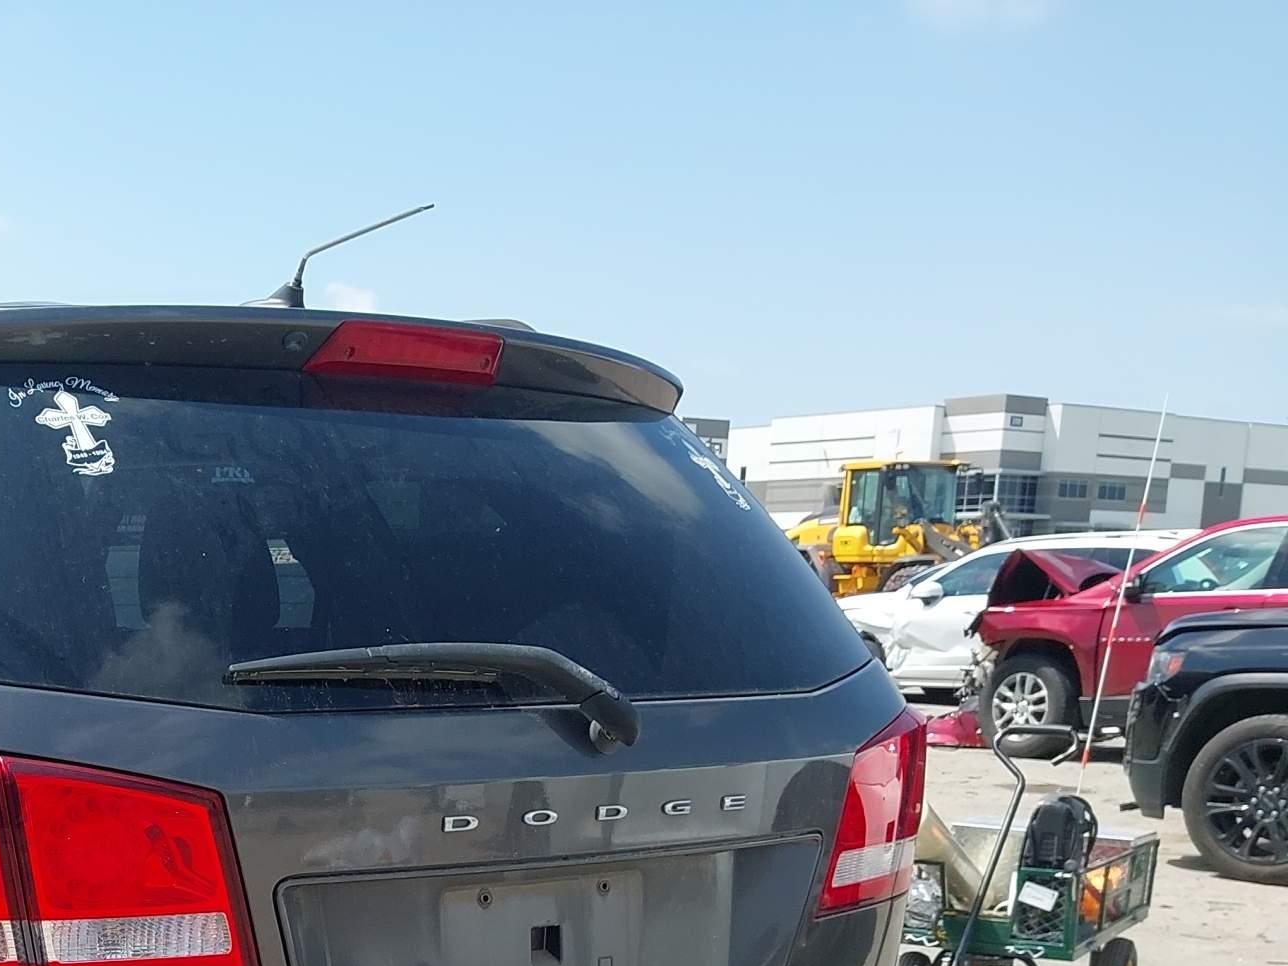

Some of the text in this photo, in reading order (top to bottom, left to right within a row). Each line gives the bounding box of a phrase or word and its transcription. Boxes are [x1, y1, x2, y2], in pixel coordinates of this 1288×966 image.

[24, 378, 64, 395] Loving
[65, 377, 120, 401] Memory
[441, 794, 747, 833] DODGE
